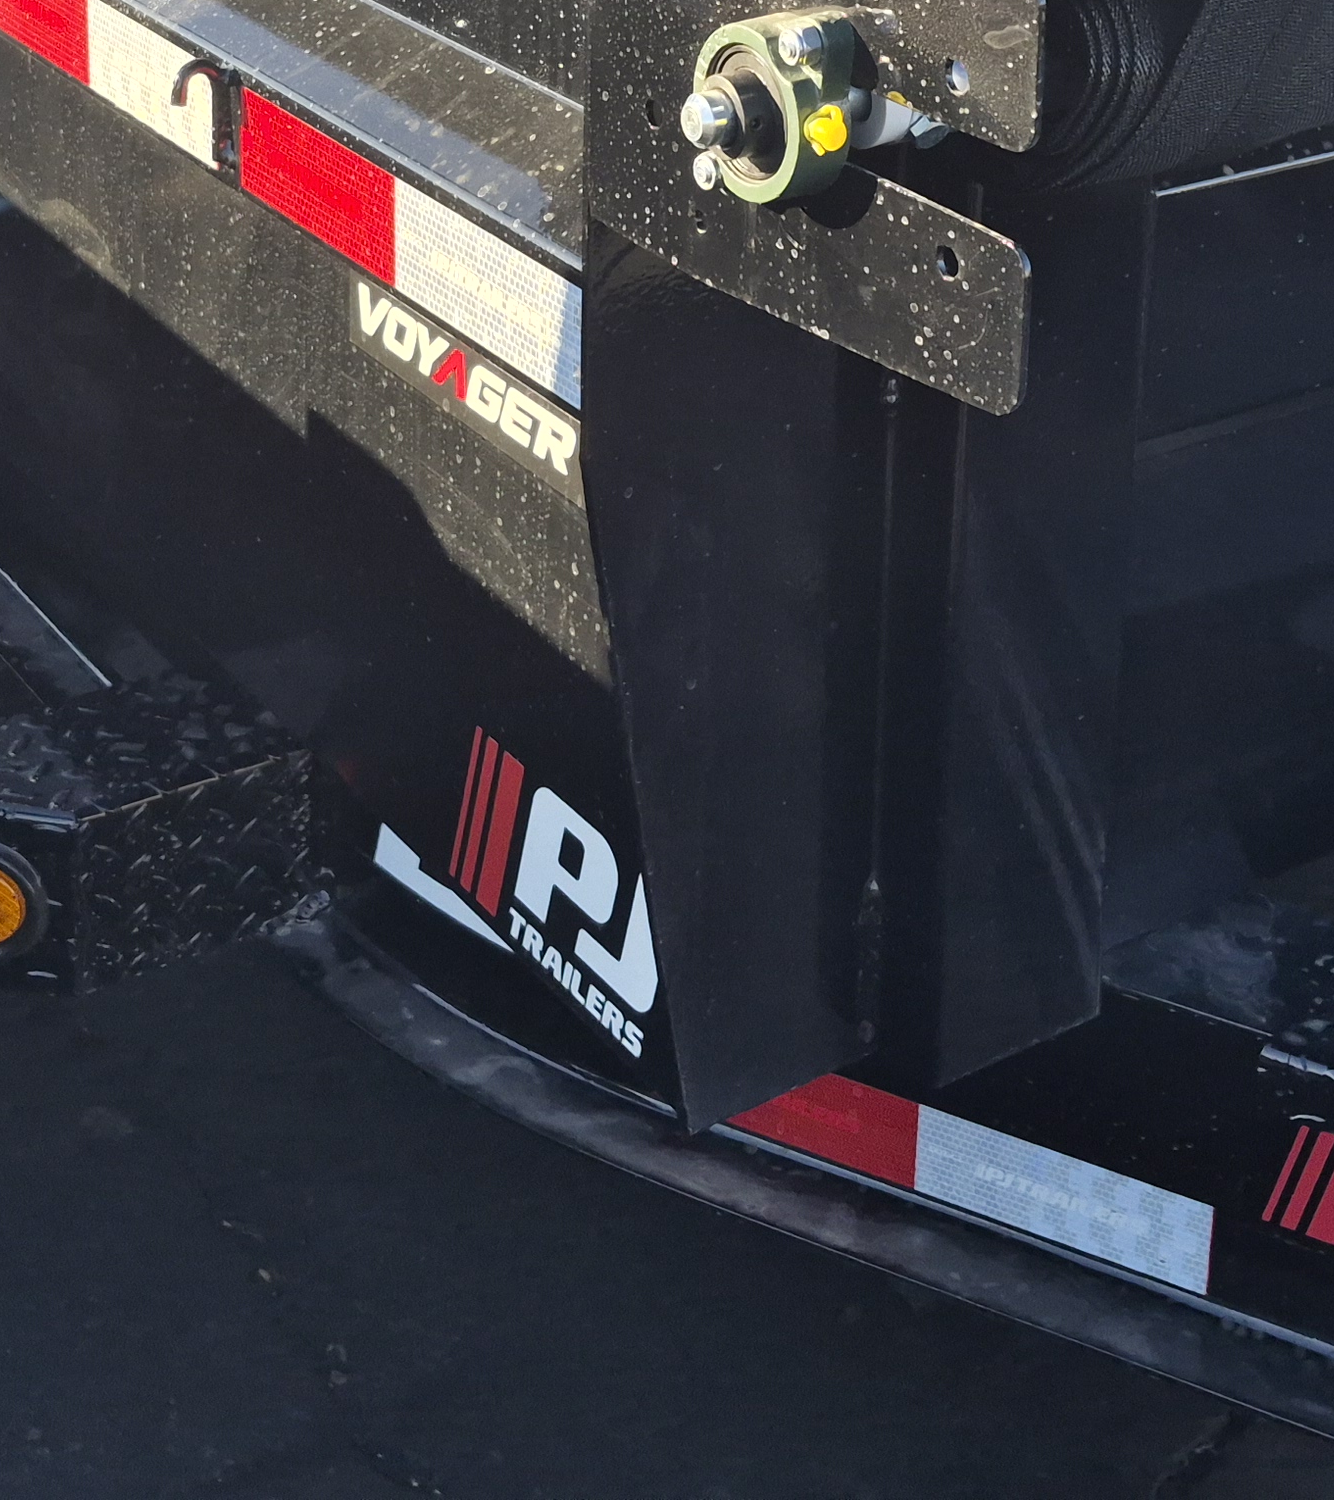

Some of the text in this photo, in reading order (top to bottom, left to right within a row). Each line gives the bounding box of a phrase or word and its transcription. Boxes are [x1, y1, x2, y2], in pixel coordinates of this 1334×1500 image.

[357, 281, 577, 476] VOYAGER
[508, 906, 645, 1059] TRAILERS
[514, 786, 659, 1014] PJ
